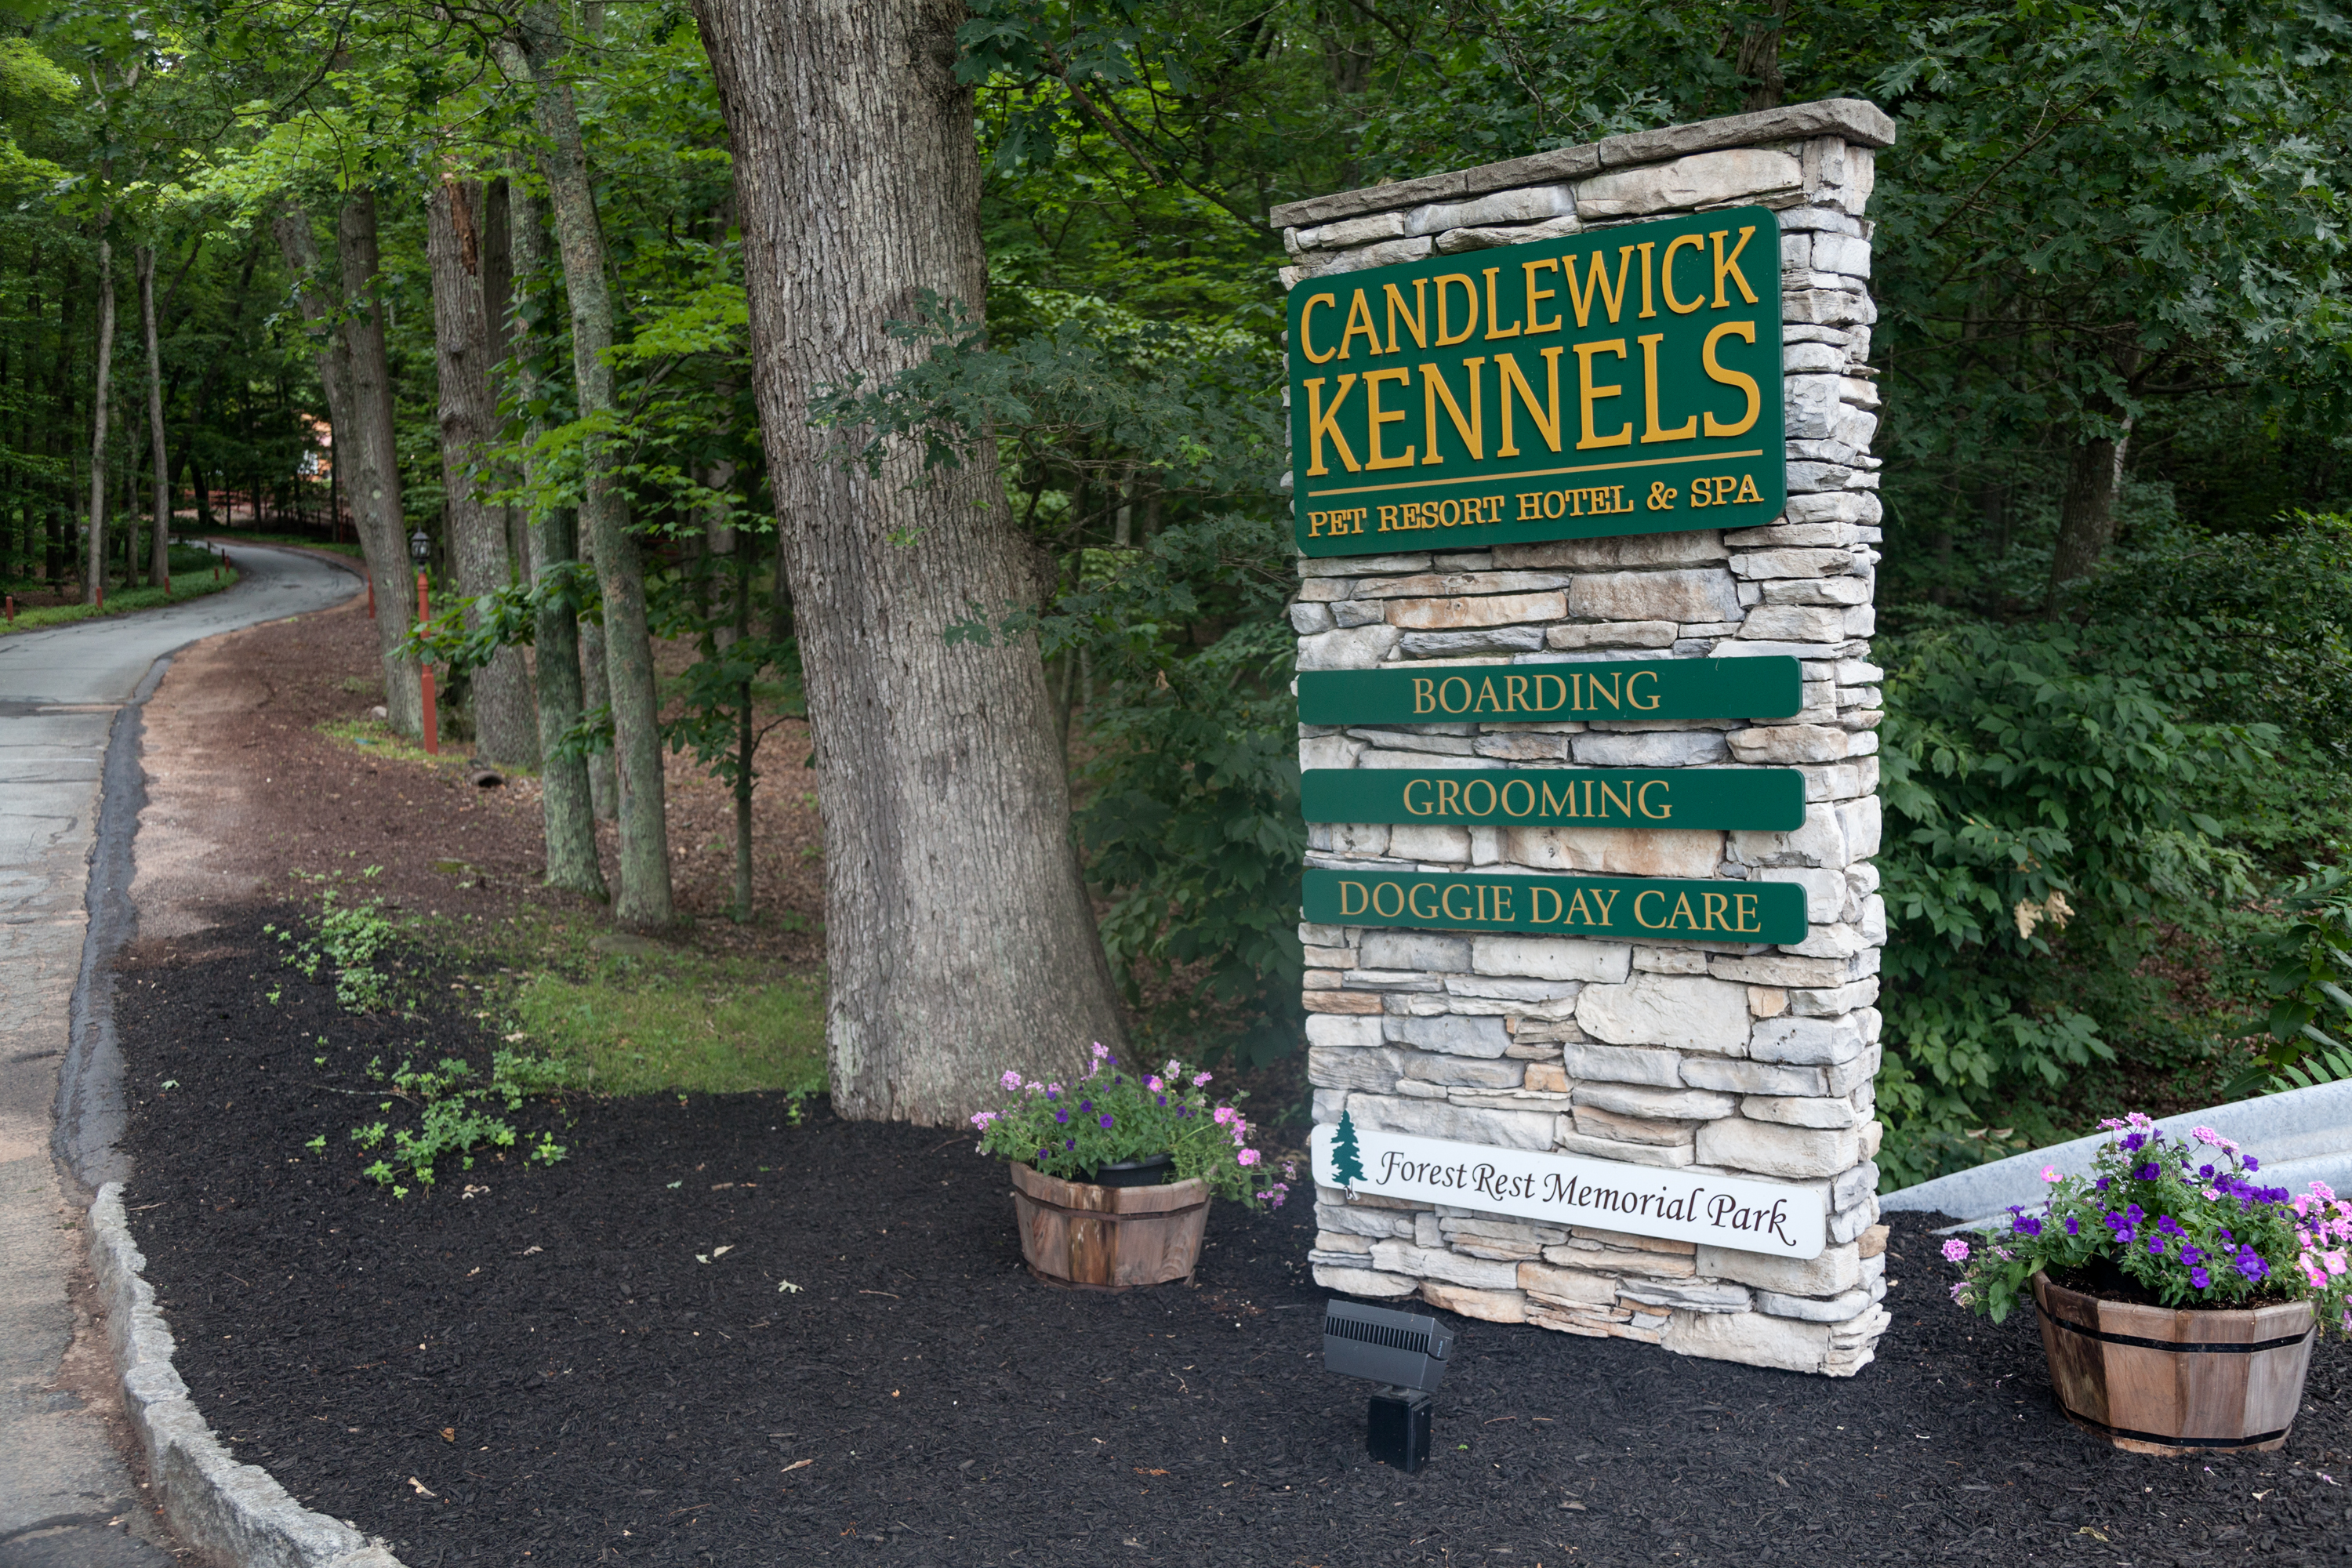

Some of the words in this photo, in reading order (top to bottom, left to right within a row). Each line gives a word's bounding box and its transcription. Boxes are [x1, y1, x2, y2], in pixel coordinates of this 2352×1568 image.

[1301, 225, 1759, 364] CANDLEWICK
[1303, 320, 1761, 477] KENNELS
[1307, 507, 1367, 538] PET
[1377, 495, 1505, 532] RESORT
[1515, 485, 1635, 521] HOTEL
[1646, 481, 1678, 510] &
[1690, 474, 1765, 508] SPA
[1412, 670, 1661, 714] BOARDING
[1403, 779, 1672, 819] GROOMING
[1338, 880, 1515, 922] DOGGIE
[1529, 886, 1620, 927] DAY
[1633, 890, 1762, 933] CARE
[1376, 1150, 1468, 1189] Forest
[1473, 1163, 1535, 1201] Rest
[1542, 1173, 1705, 1223] Memorial
[1708, 1193, 1797, 1247] Park
